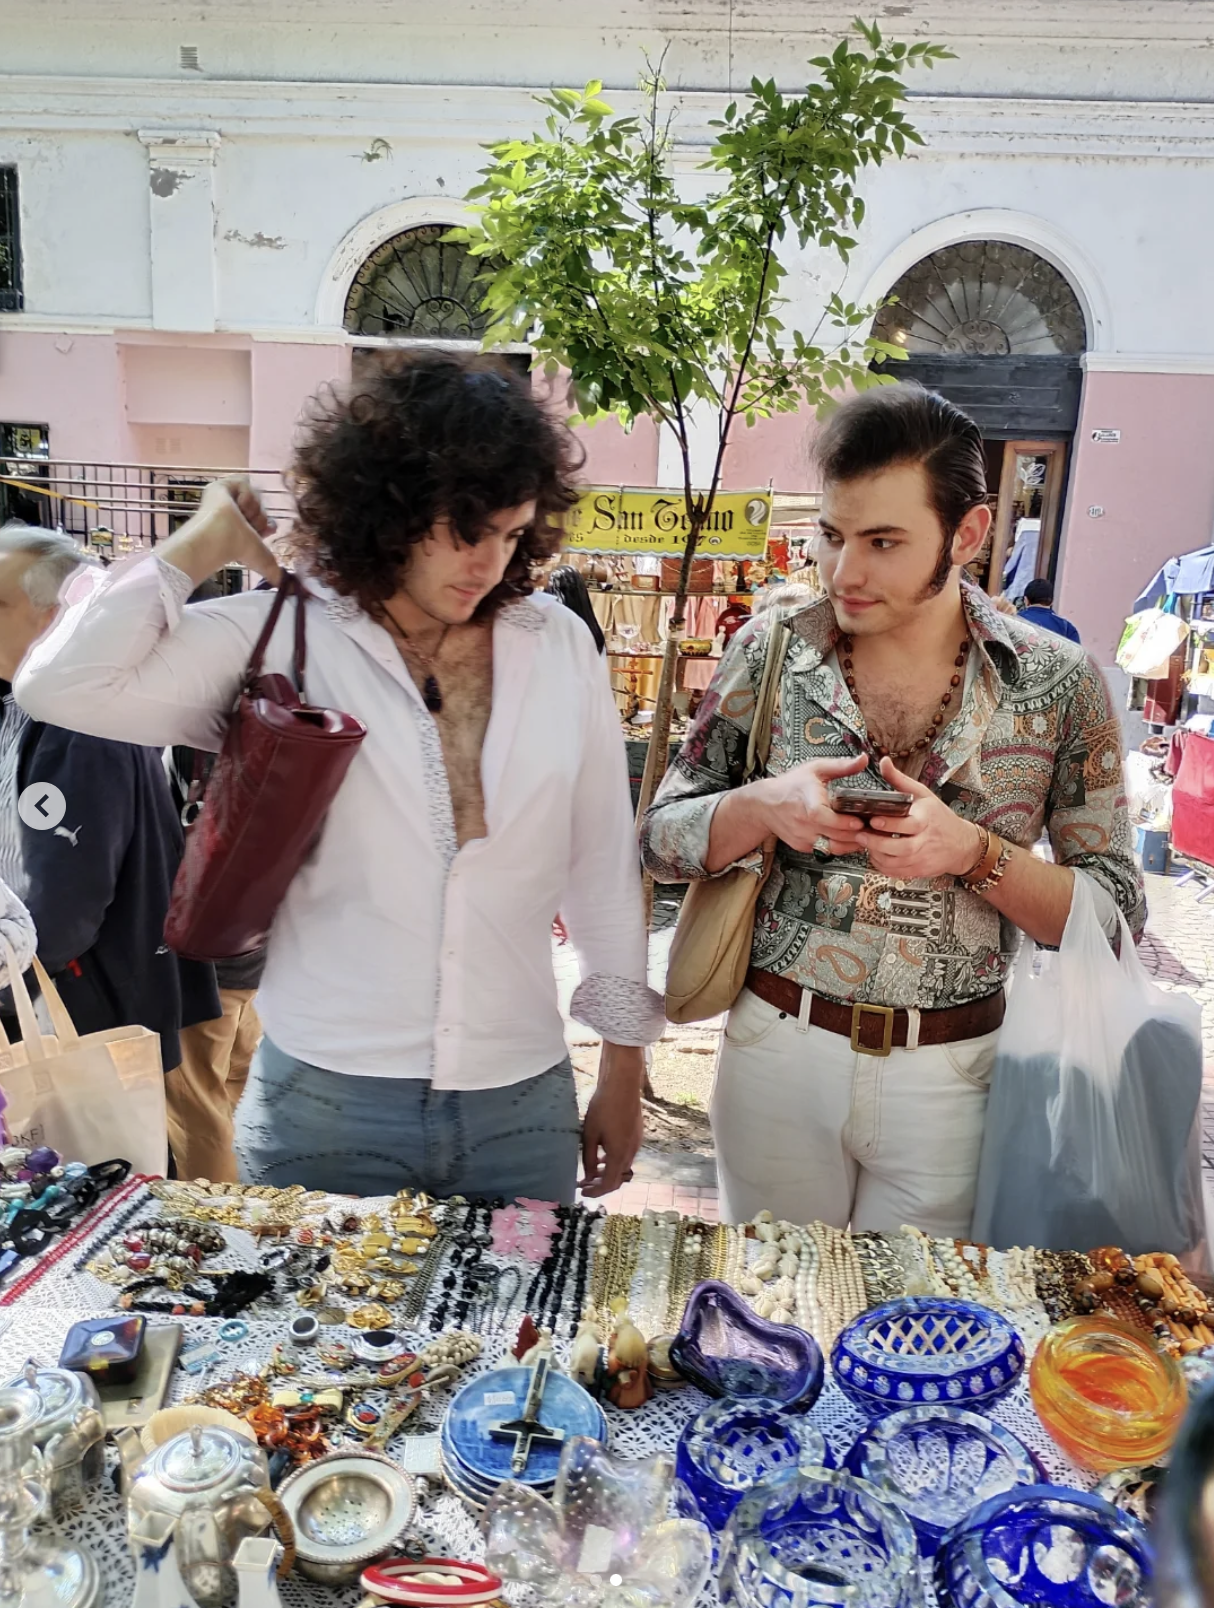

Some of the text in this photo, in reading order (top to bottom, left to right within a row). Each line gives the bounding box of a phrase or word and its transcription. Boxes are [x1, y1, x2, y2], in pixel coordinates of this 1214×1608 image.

[587, 494, 644, 535] San
[650, 498, 734, 533] Temo
[623, 534, 665, 545] desde
